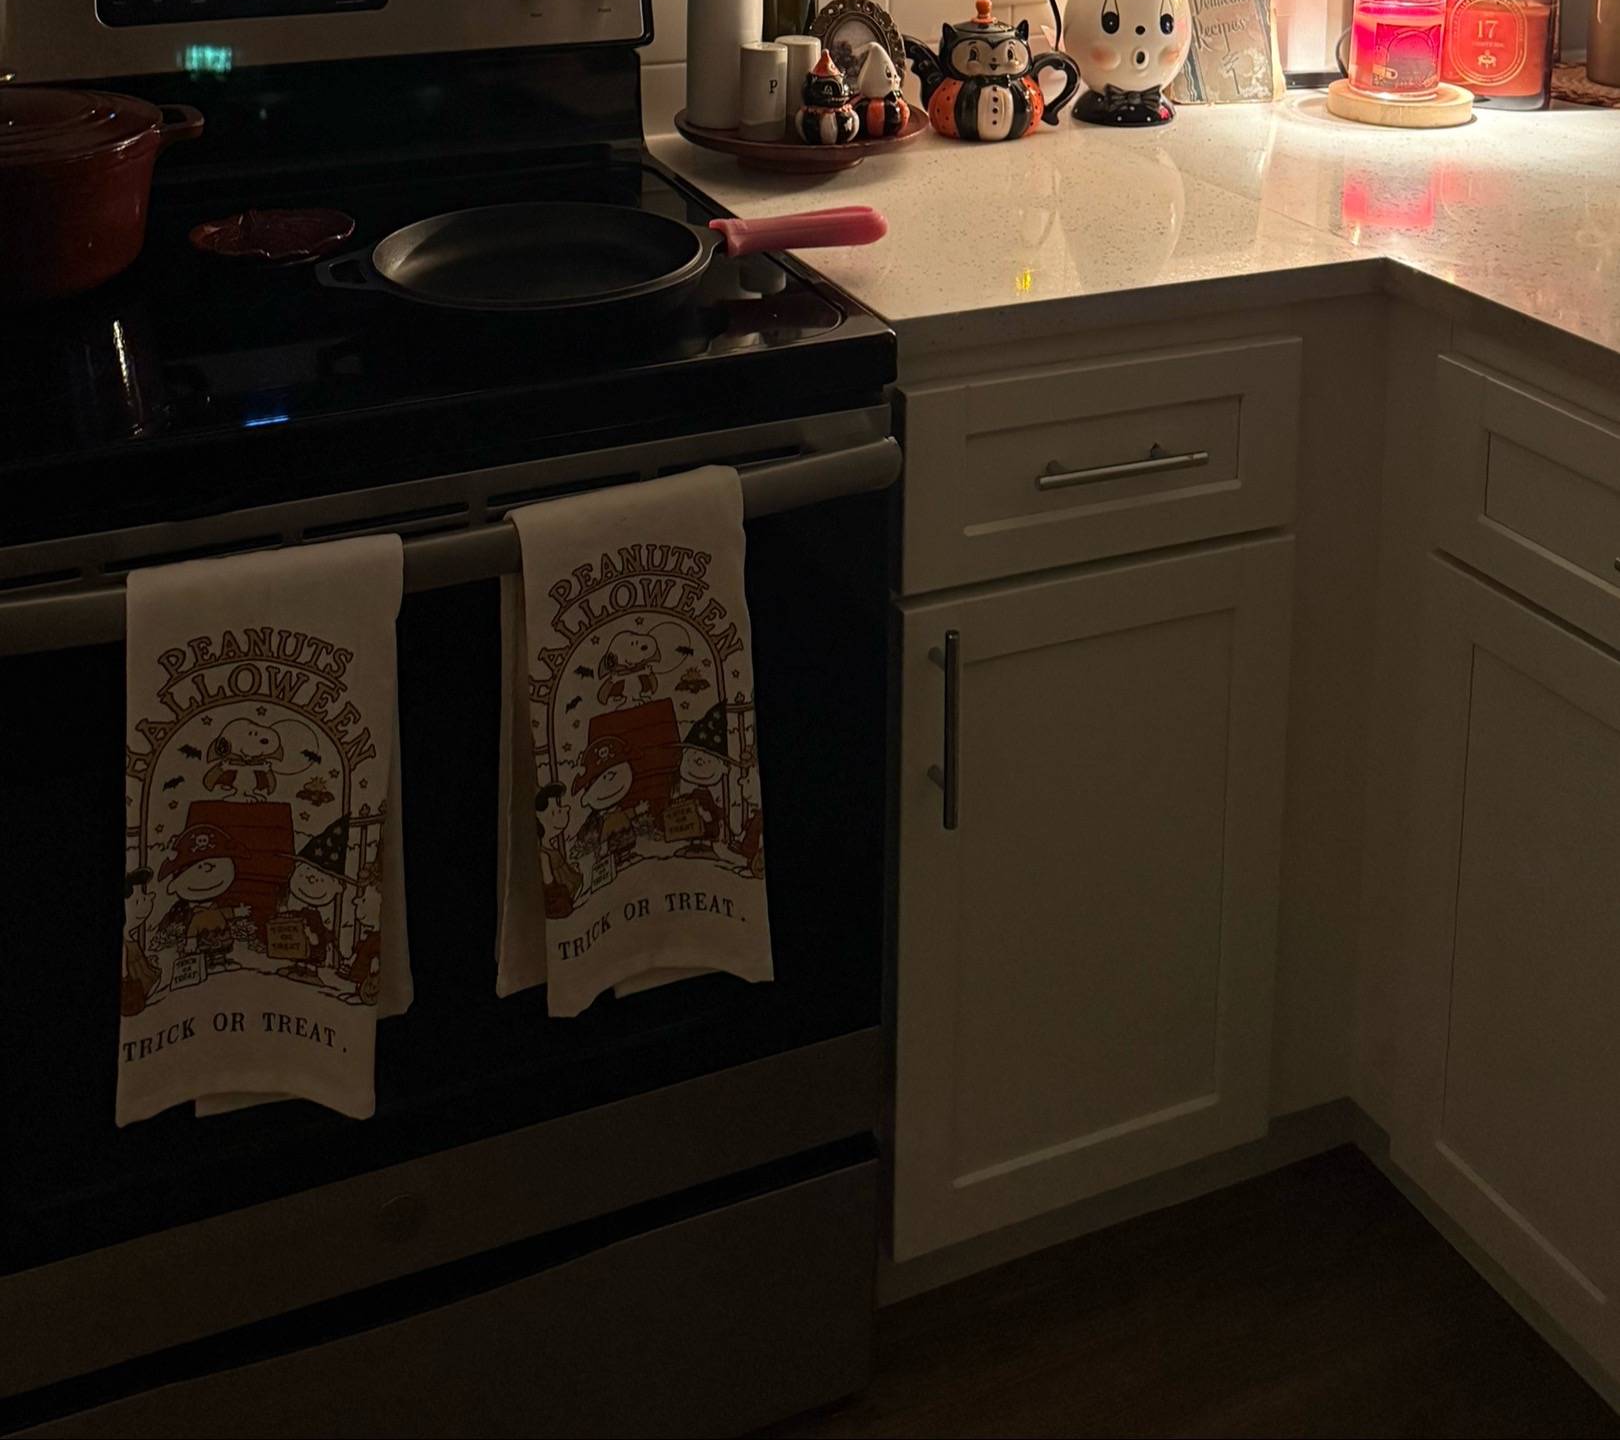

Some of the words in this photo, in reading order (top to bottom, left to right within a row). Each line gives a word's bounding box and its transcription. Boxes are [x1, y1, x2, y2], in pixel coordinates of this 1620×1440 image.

[1191, 15, 1248, 53] Recipes
[1477, 19, 1499, 39] 17
[548, 544, 713, 608] PEANUTS
[157, 627, 354, 681] PEANUTS
[529, 578, 744, 704] HALLOWEEN
[126, 662, 377, 784] HALLOWEEN
[558, 911, 611, 961] TRICK
[624, 898, 650, 921] OR
[122, 1016, 196, 1062] TRICK
[213, 1012, 246, 1033] OR
